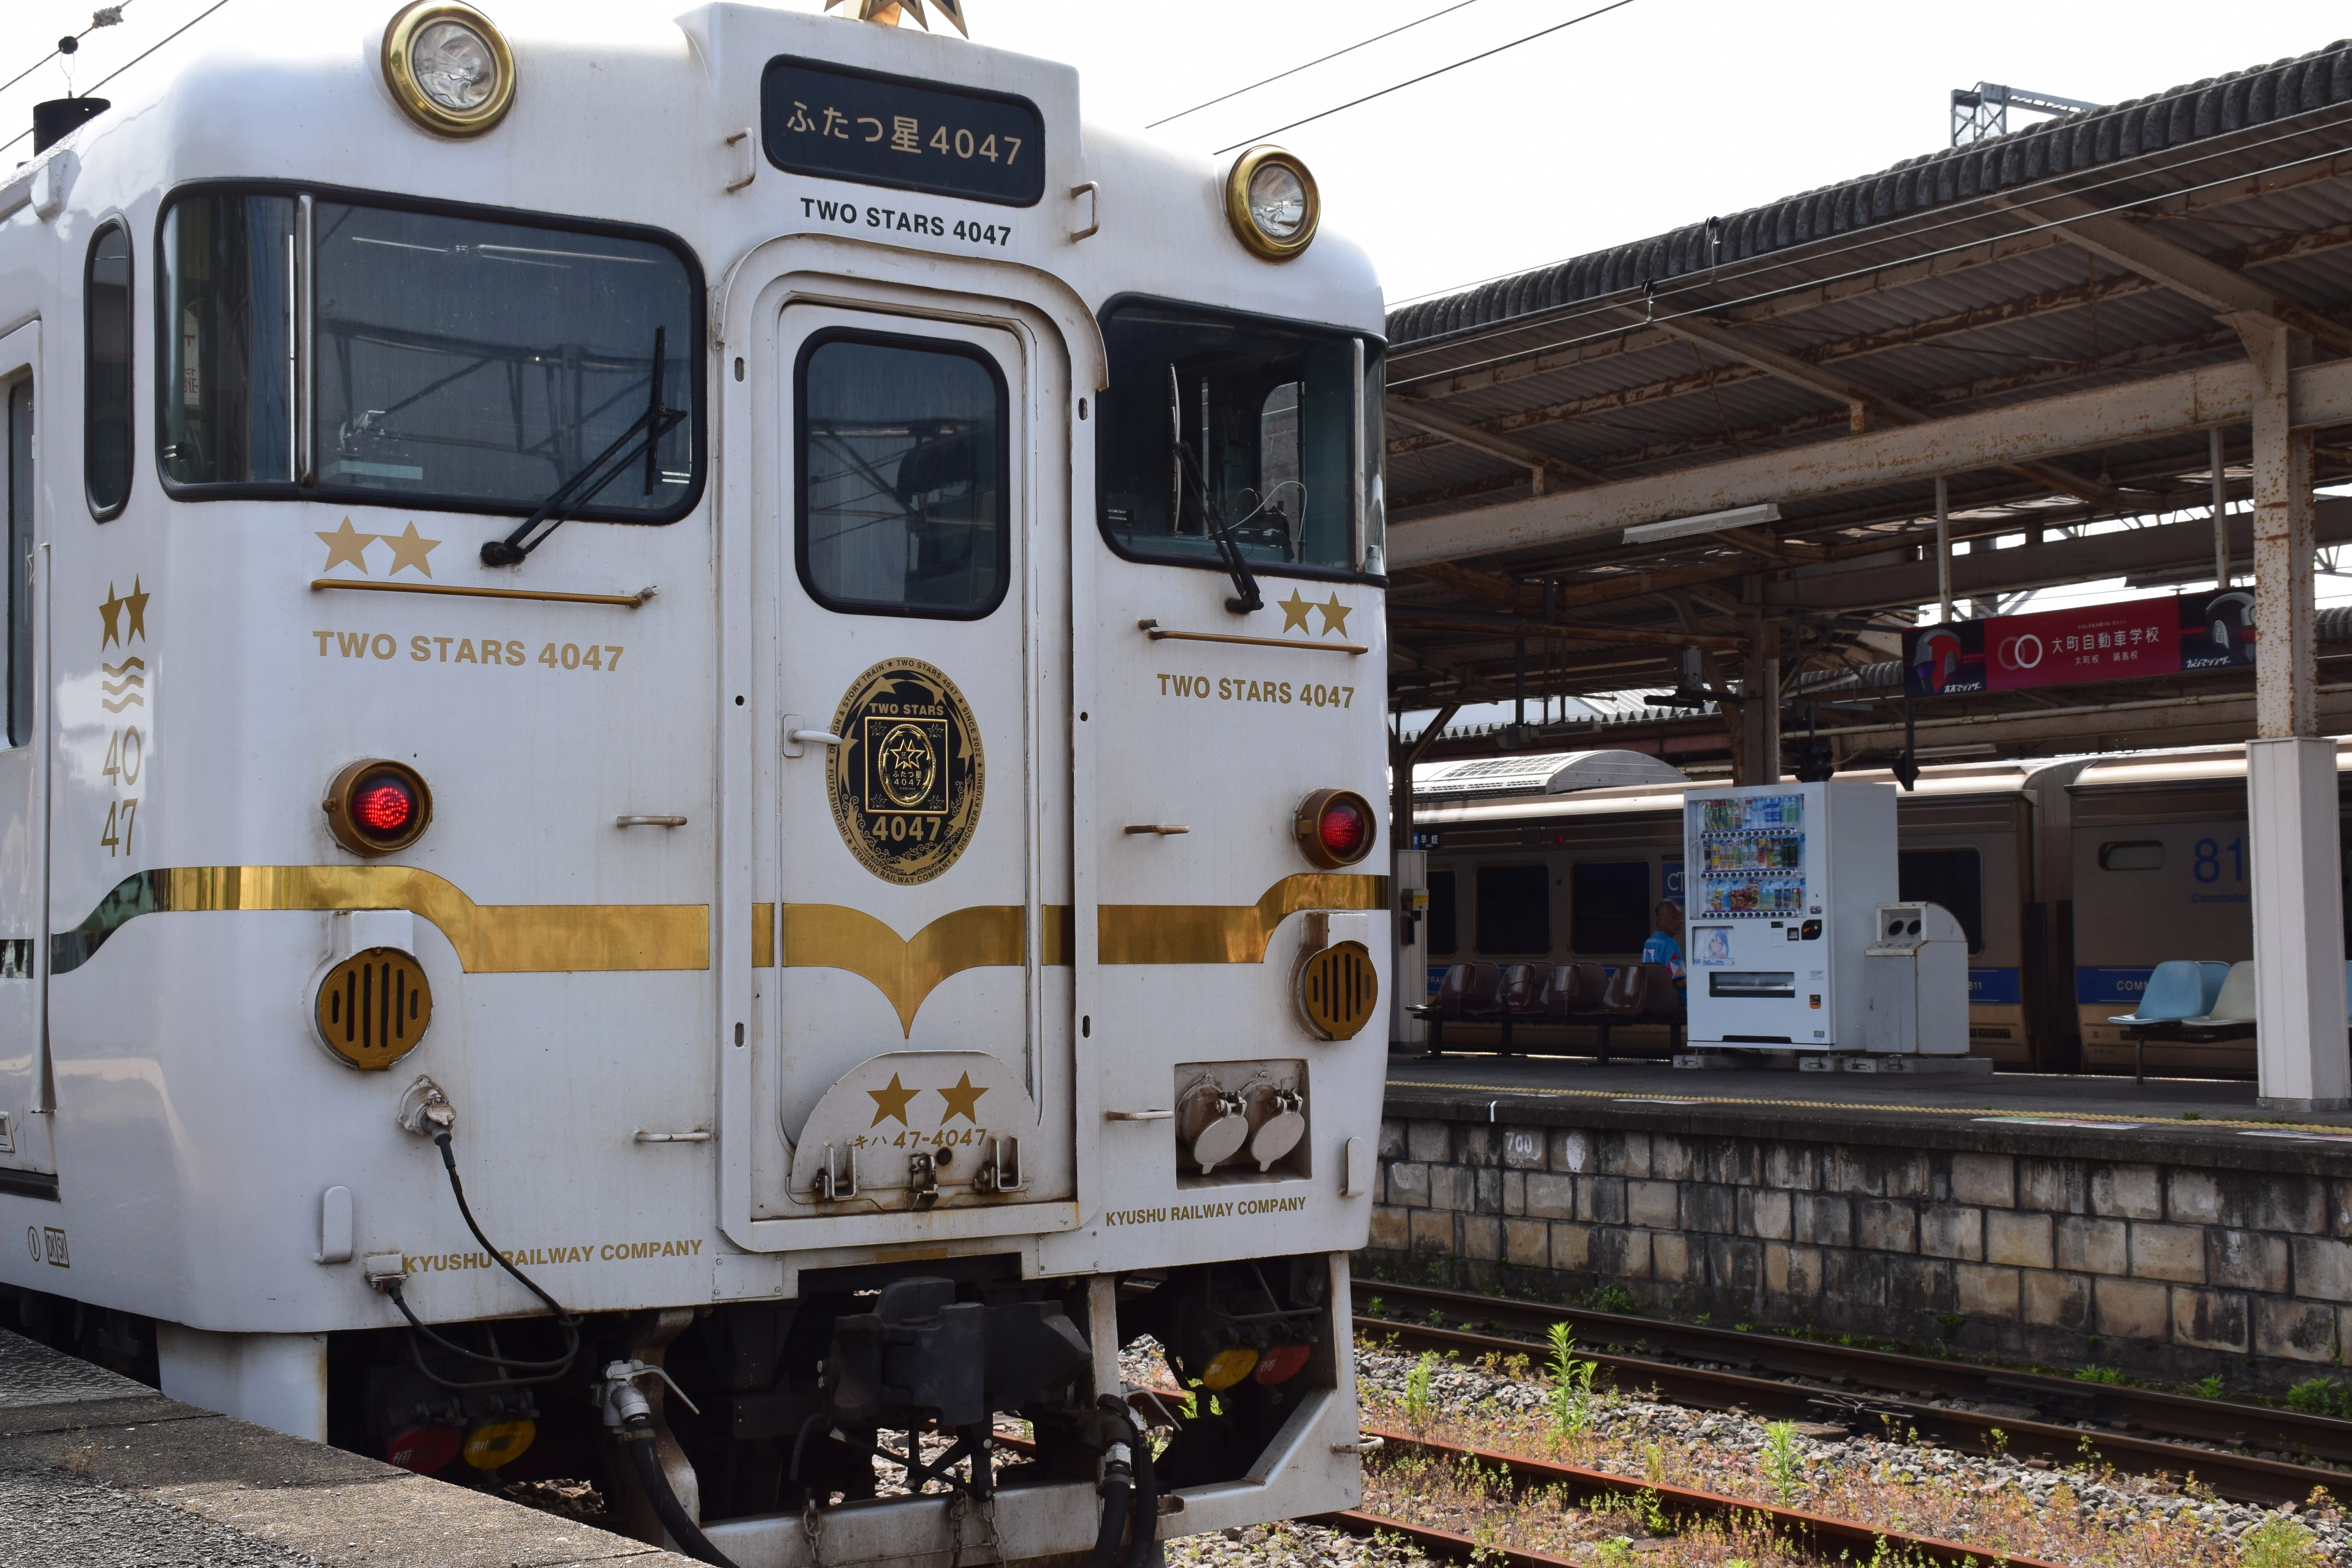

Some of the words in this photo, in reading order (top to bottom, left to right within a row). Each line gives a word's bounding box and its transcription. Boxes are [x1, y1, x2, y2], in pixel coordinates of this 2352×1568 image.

[800, 197, 857, 224] TWO
[866, 207, 944, 237] STARS
[953, 220, 1011, 246] 4047
[312, 631, 397, 660] TWO
[410, 635, 526, 666] STARS
[538, 642, 624, 671] 4047
[2052, 626, 2160, 654] 大町自動車学校
[2074, 655, 2100, 666] 大町校
[917, 662, 942, 679] STARS
[943, 679, 958, 695] 4047
[1157, 674, 1210, 699] TWO
[1219, 677, 1292, 704] STARS
[1300, 684, 1354, 709] 4047
[829, 719, 842, 754] DIGN
[843, 681, 862, 708] STORY
[862, 664, 884, 682] TRAIN
[869, 703, 898, 714] TWO
[903, 704, 944, 716] STARS
[962, 706, 976, 734] SINCE
[973, 737, 982, 758] 2022
[102, 725, 141, 786] 40
[893, 771, 922, 779] ふたつ星
[828, 769, 849, 836] FUTATSUBOSHI
[957, 809, 978, 851] DISCOVER
[975, 773, 983, 808] KYUSHU
[101, 798, 138, 857] 47
[872, 816, 941, 841] 4047
[1420, 834, 1438, 845] 早岐
[852, 846, 879, 873] KYUSHU
[879, 870, 915, 884] RAILWAY
[917, 858, 952, 882] COMPANY
[1505, 1132, 1532, 1153] 700
[1106, 1208, 1166, 1227] KYUSHU
[1171, 1202, 1234, 1221] RAILWAY
[1238, 1196, 1306, 1215] COMPANY
[404, 1252, 492, 1273] KYUSHU
[500, 1246, 595, 1267] RAILWAY
[600, 1240, 703, 1261] COMPANY
[469, 1439, 490, 1454] 制
